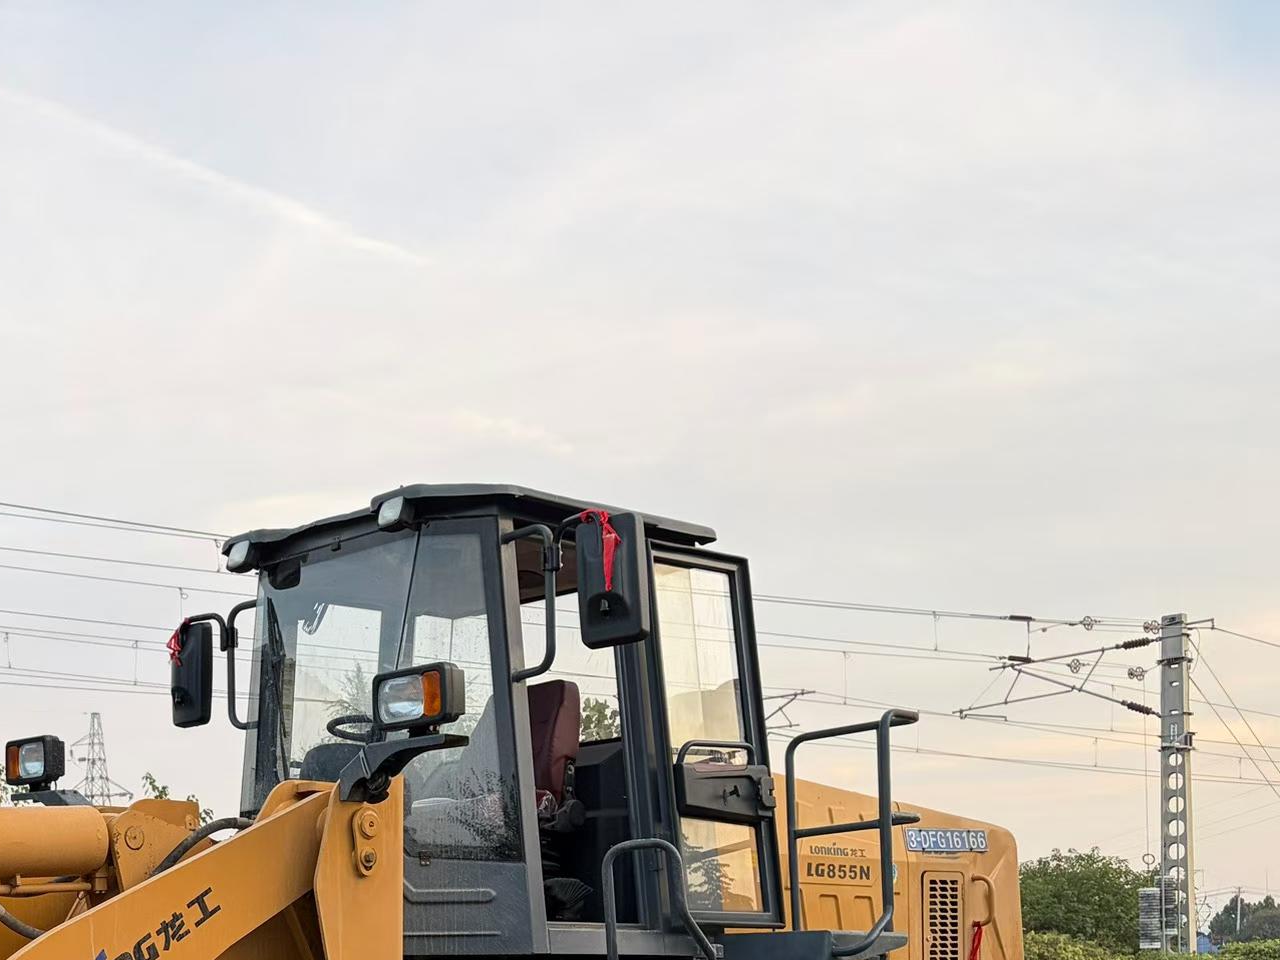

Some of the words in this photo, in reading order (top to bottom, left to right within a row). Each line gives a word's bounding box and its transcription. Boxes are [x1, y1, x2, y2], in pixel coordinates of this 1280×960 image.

[908, 830, 986, 849] 3-DFG16166
[806, 862, 871, 880] LG855N
[155, 886, 222, 951] 龙工
